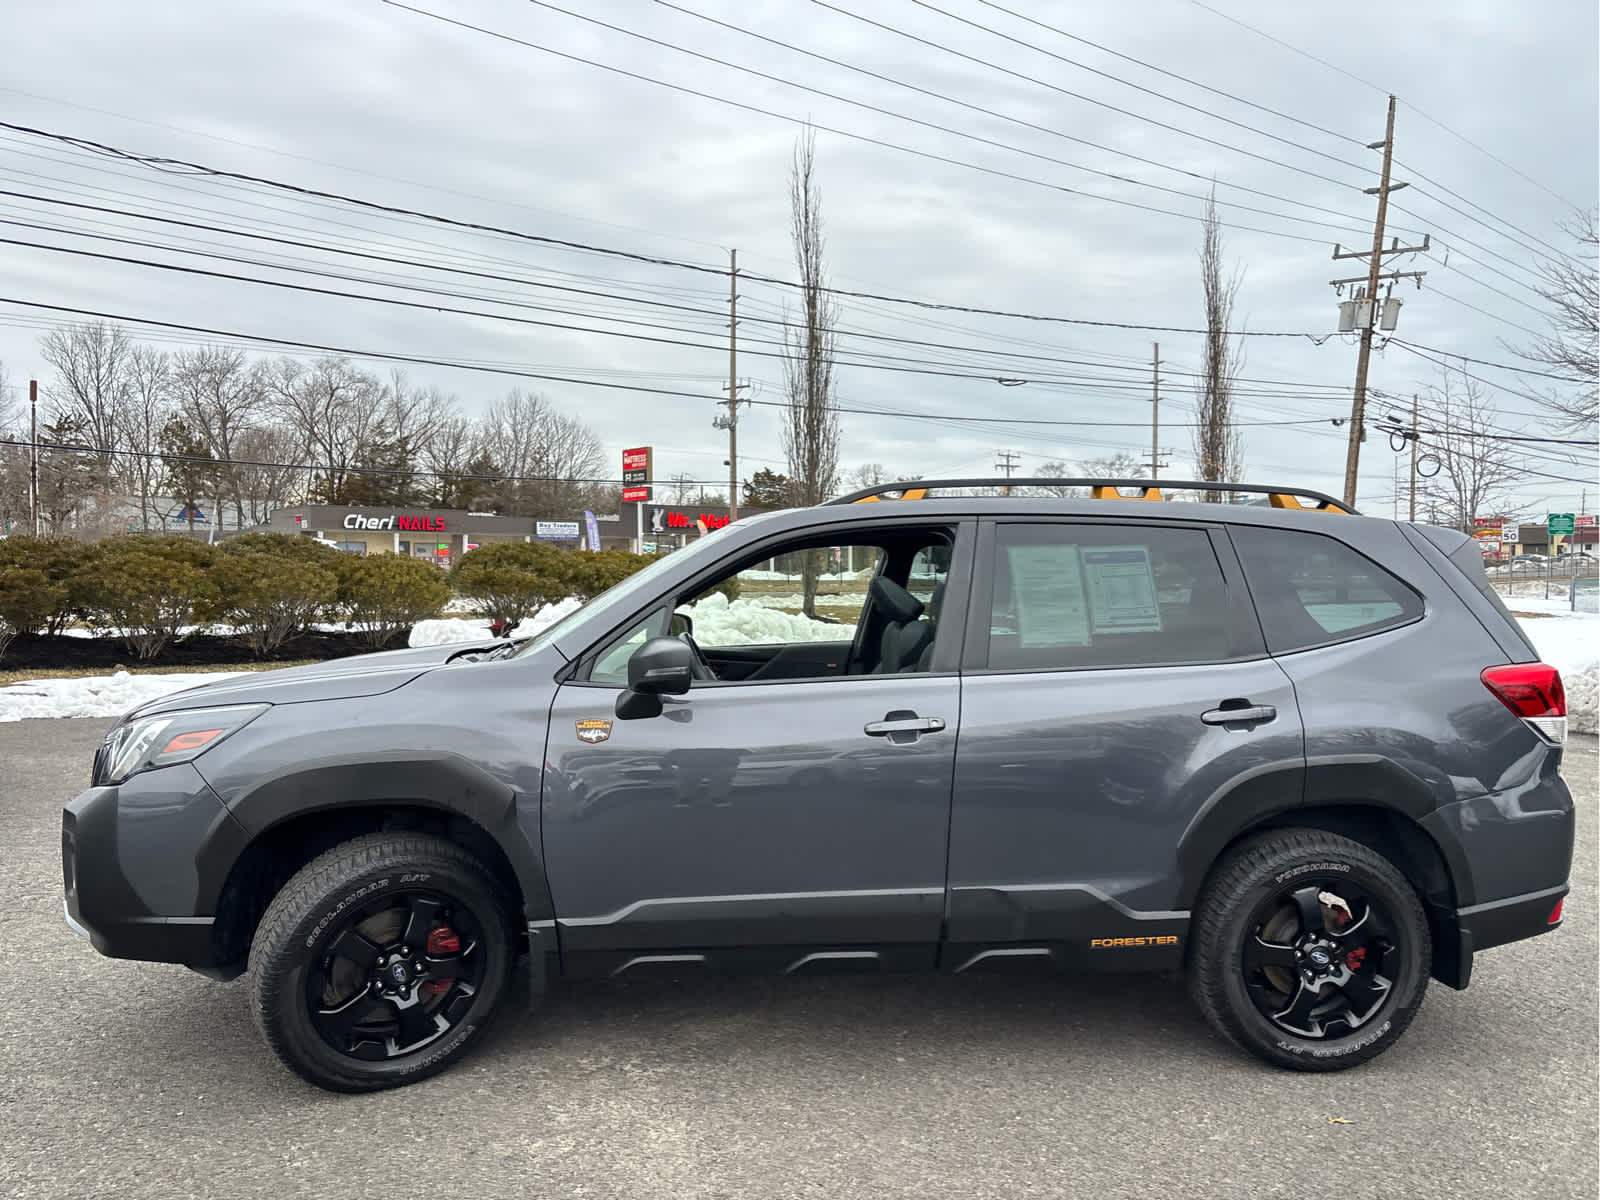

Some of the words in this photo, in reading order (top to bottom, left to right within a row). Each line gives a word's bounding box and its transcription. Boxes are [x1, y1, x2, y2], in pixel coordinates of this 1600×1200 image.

[343, 514, 395, 530] Cheri
[399, 515, 446, 531] NAILS
[667, 512, 694, 528] Mr.
[1503, 533, 1517, 541] 50
[1090, 936, 1178, 948] FORESTER
